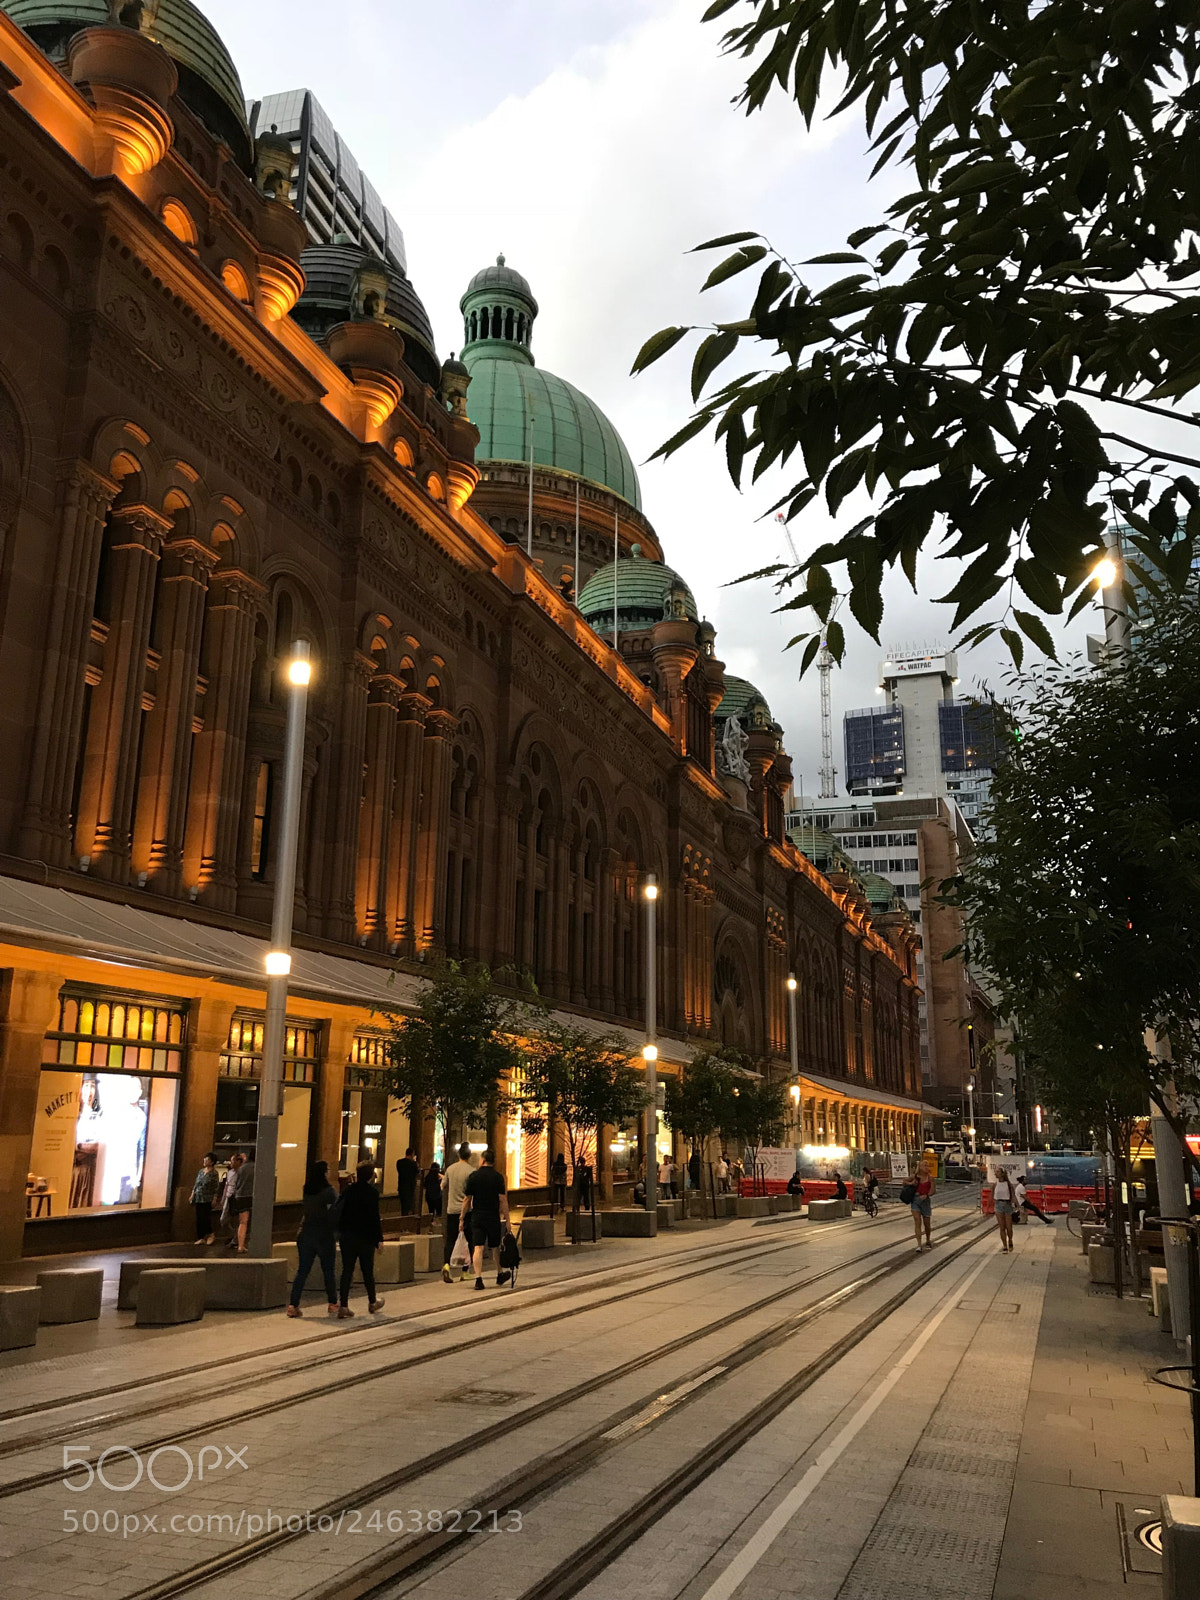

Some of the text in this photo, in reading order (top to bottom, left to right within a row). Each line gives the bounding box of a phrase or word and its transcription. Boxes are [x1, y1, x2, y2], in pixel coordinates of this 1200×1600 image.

[908, 662, 931, 670] WATPAC
[45, 1095, 65, 1118] MAKE
[66, 1092, 73, 1104] IT
